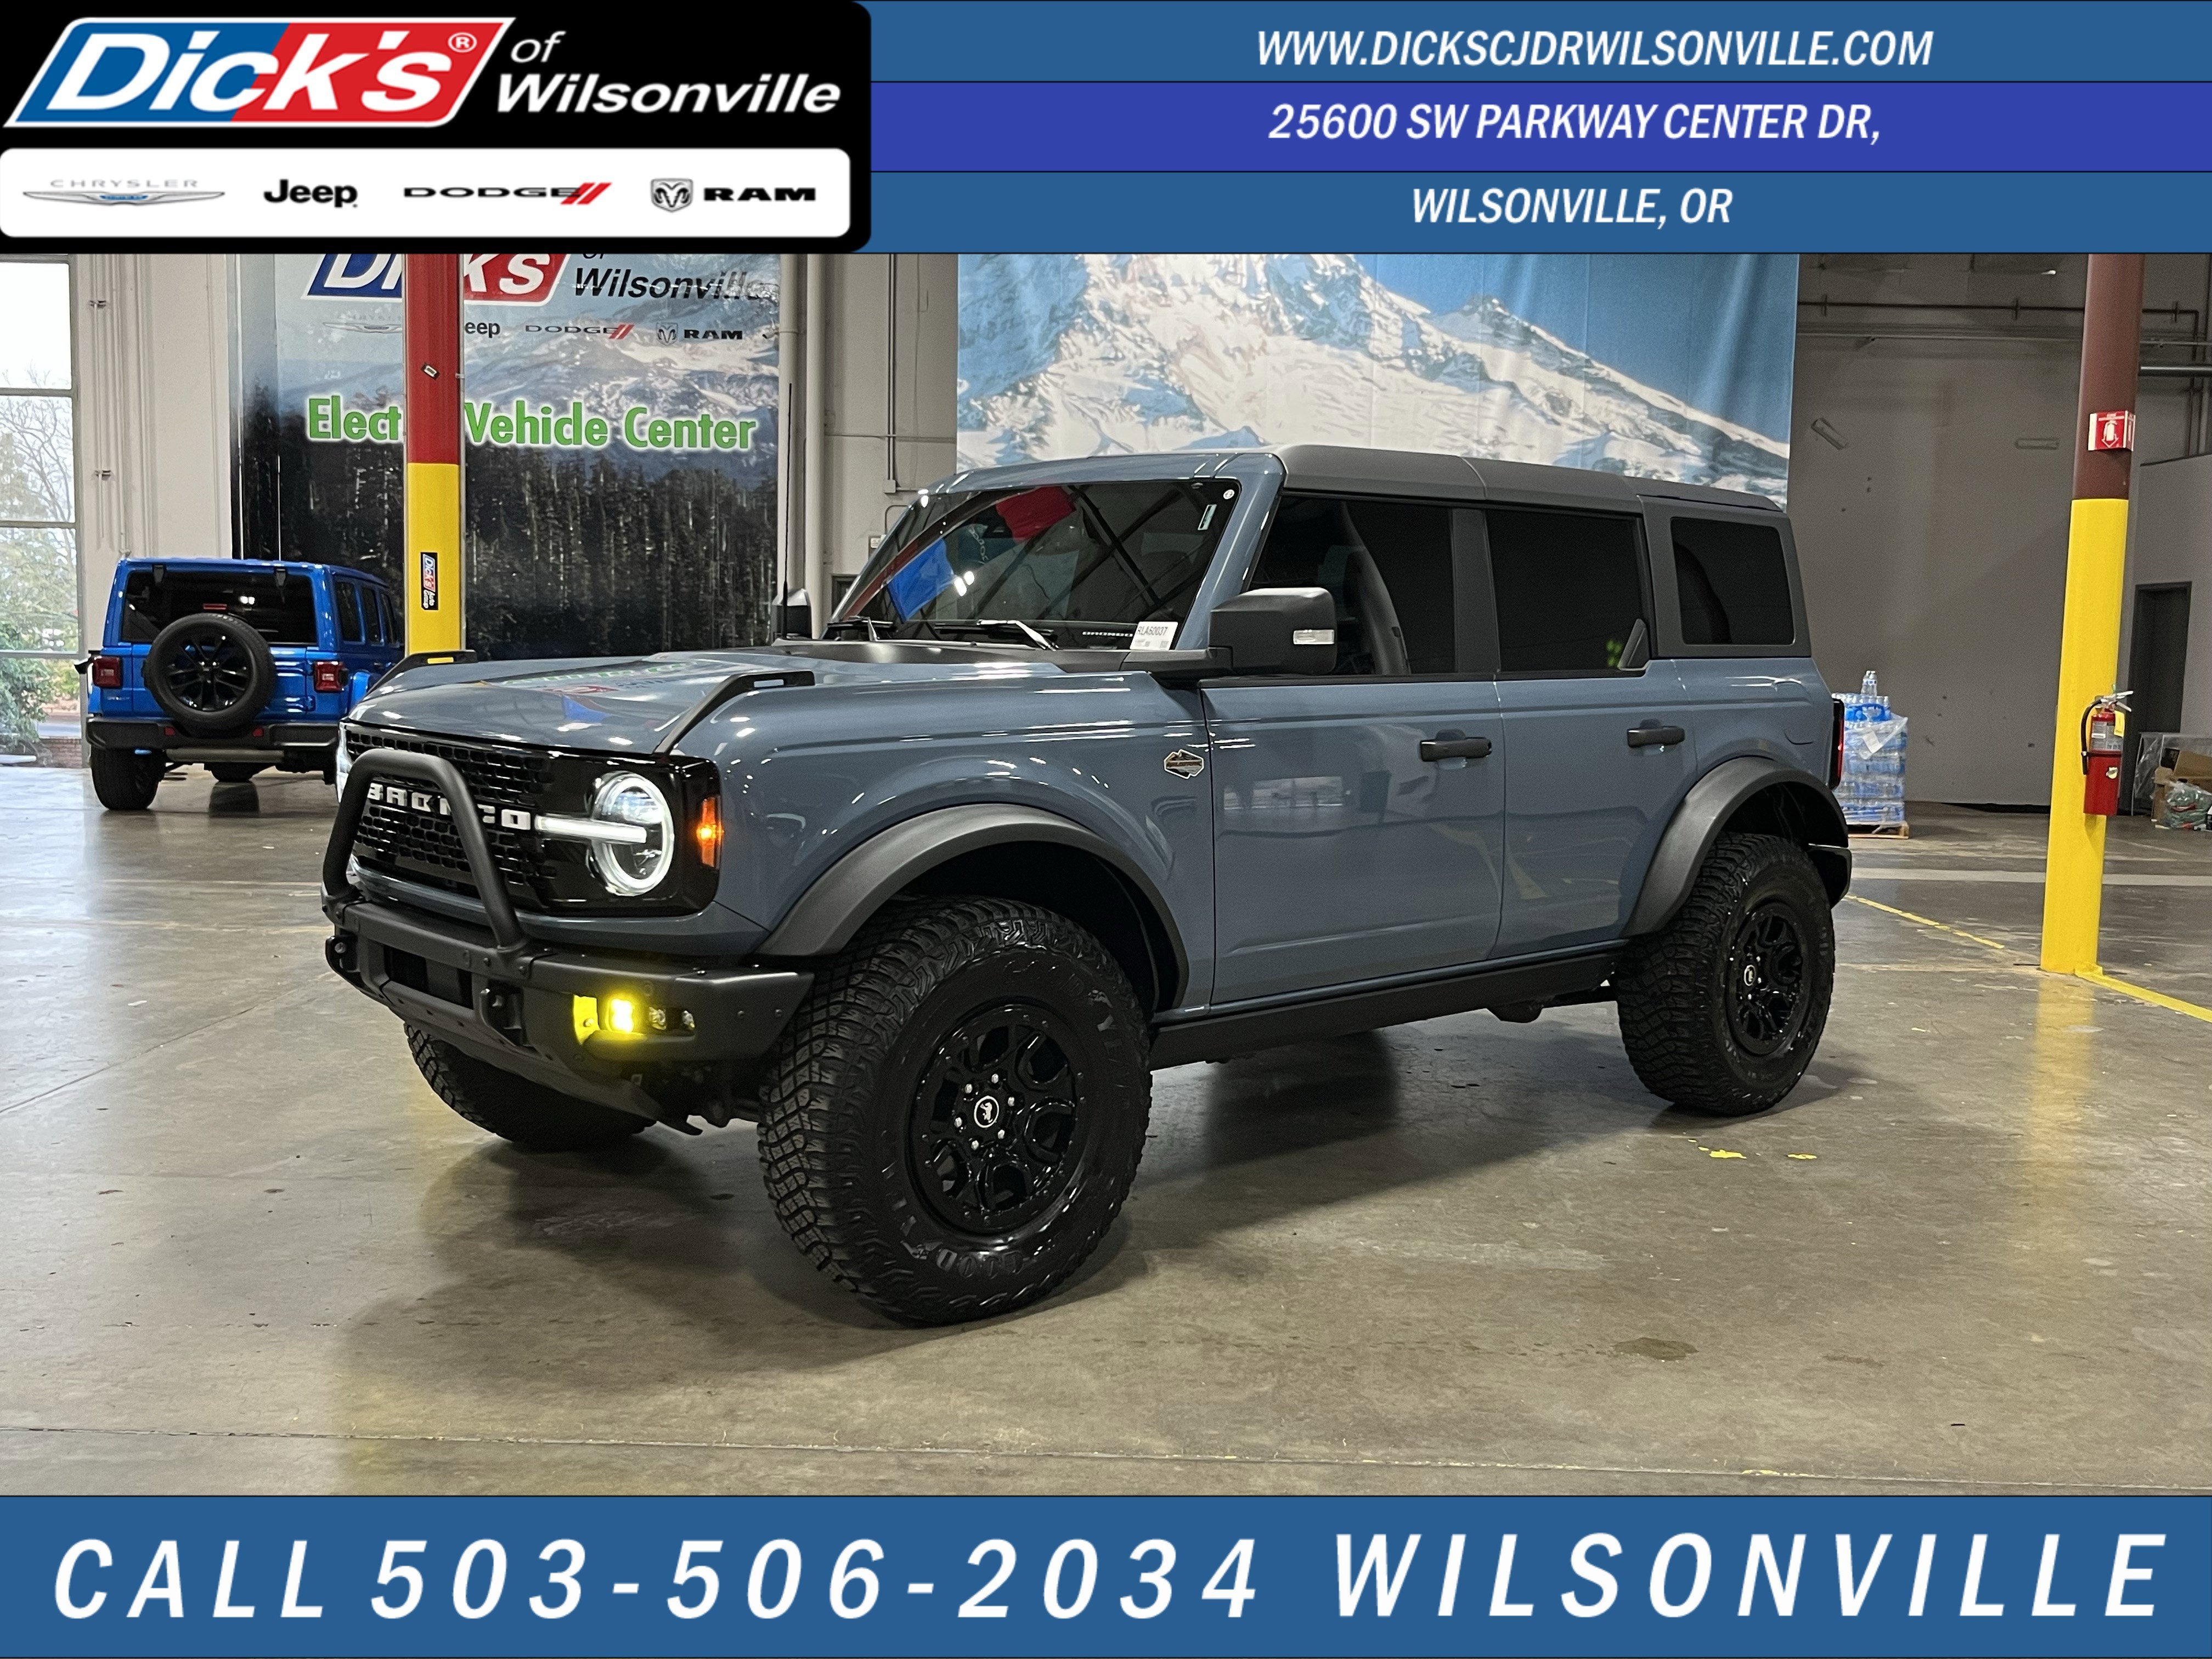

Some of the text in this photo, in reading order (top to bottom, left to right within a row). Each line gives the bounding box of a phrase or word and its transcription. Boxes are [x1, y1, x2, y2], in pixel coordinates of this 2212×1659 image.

[464, 321, 500, 338] eep
[525, 325, 619, 334] DODGE
[684, 329, 743, 340] RAM
[309, 395, 757, 449] Elect Vehicle Center
